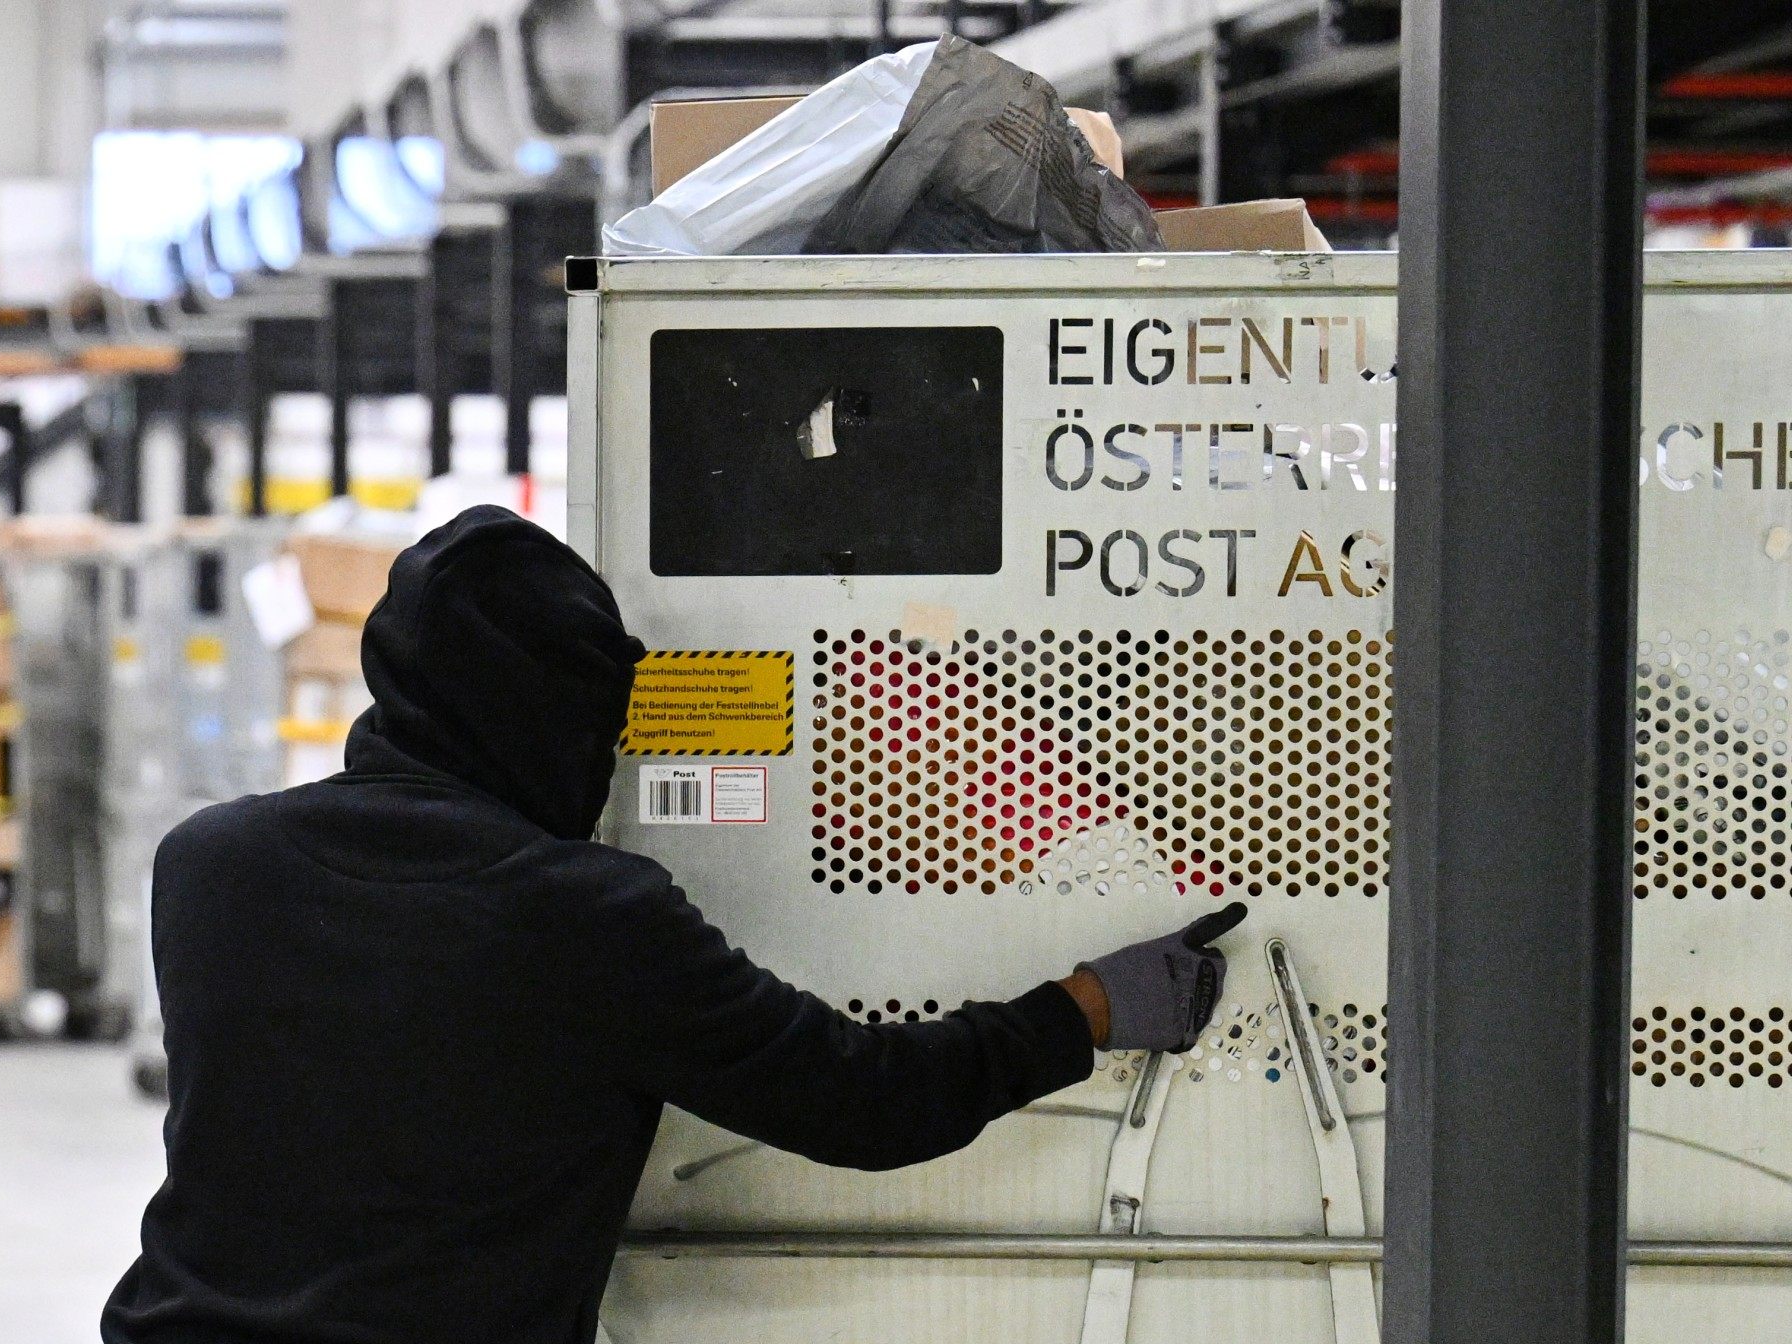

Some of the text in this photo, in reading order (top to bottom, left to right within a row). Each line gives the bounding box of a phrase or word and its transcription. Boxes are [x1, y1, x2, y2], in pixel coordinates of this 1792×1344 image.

[1048, 317, 1398, 385] EIGENTU
[1045, 529, 1390, 597] POST AG
[633, 668, 715, 676] Sicherheitsschuhe
[632, 684, 719, 693] Schutzhandschuhe
[632, 701, 779, 711] Bei Bedienung der Feststellhebel
[642, 713, 666, 721] Hand
[686, 713, 707, 721] dem
[708, 713, 784, 721] Schwenkbereich
[632, 729, 668, 738] Zuggriff
[673, 770, 696, 778] Post
